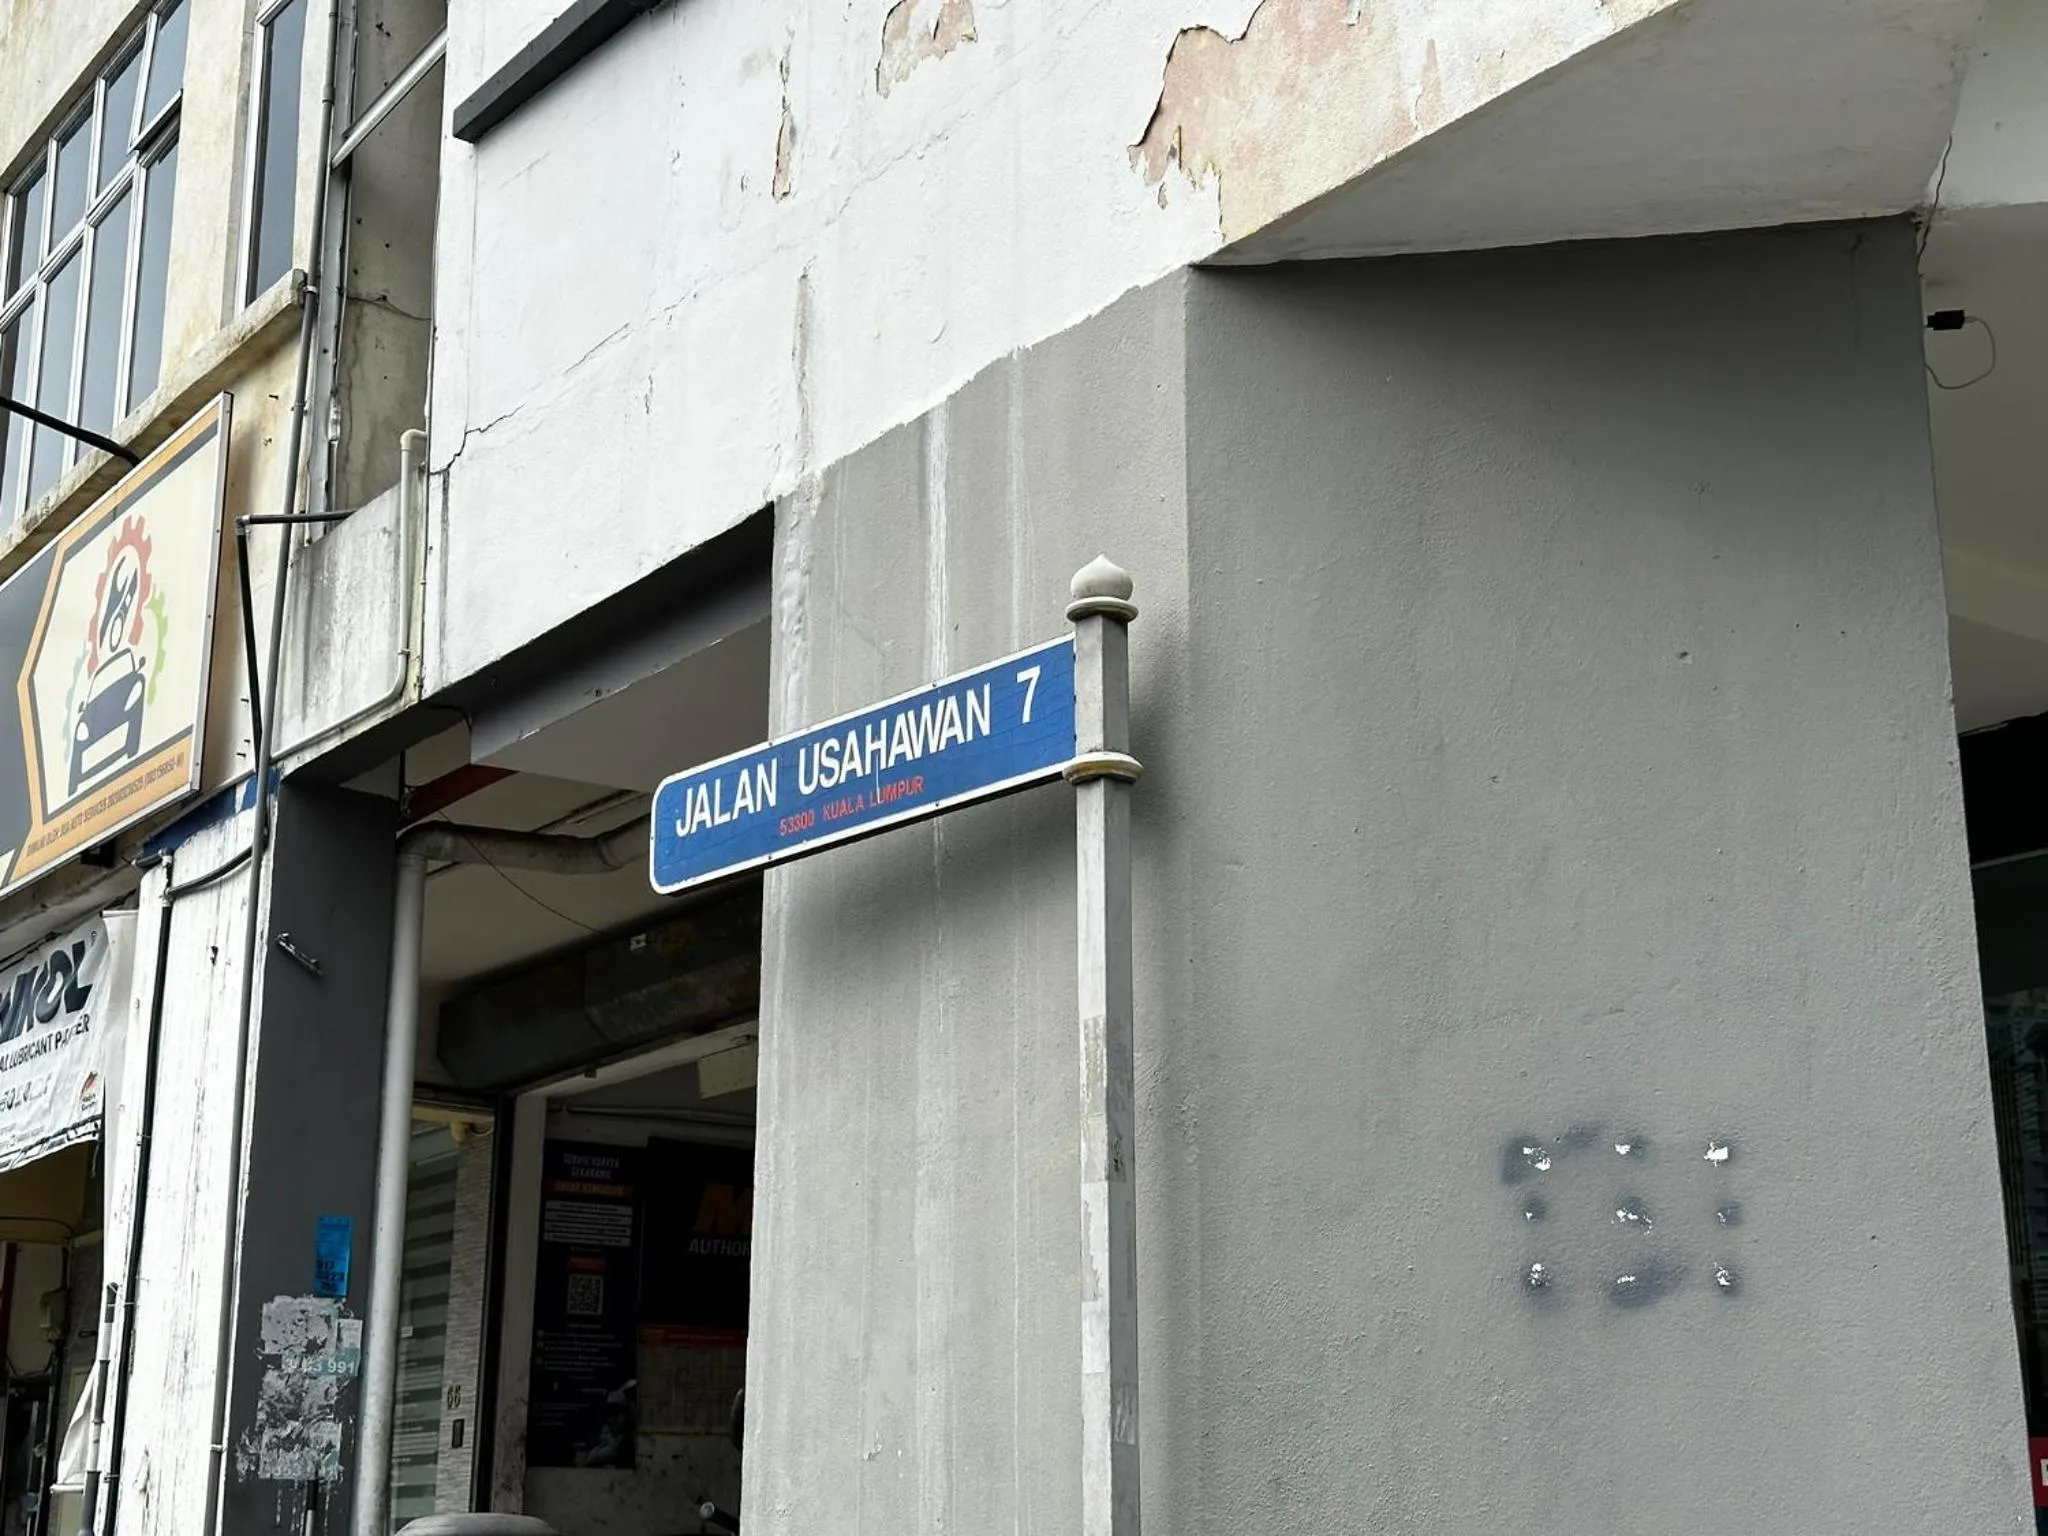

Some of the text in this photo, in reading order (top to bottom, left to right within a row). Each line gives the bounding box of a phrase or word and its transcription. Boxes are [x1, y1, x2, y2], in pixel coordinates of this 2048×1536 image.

[676, 665, 1041, 838] JALAN USAHAWAN 7
[822, 794, 865, 823] KUALA
[869, 776, 925, 807] LUMPUR
[9, 1033, 54, 1071] LUBRICANT
